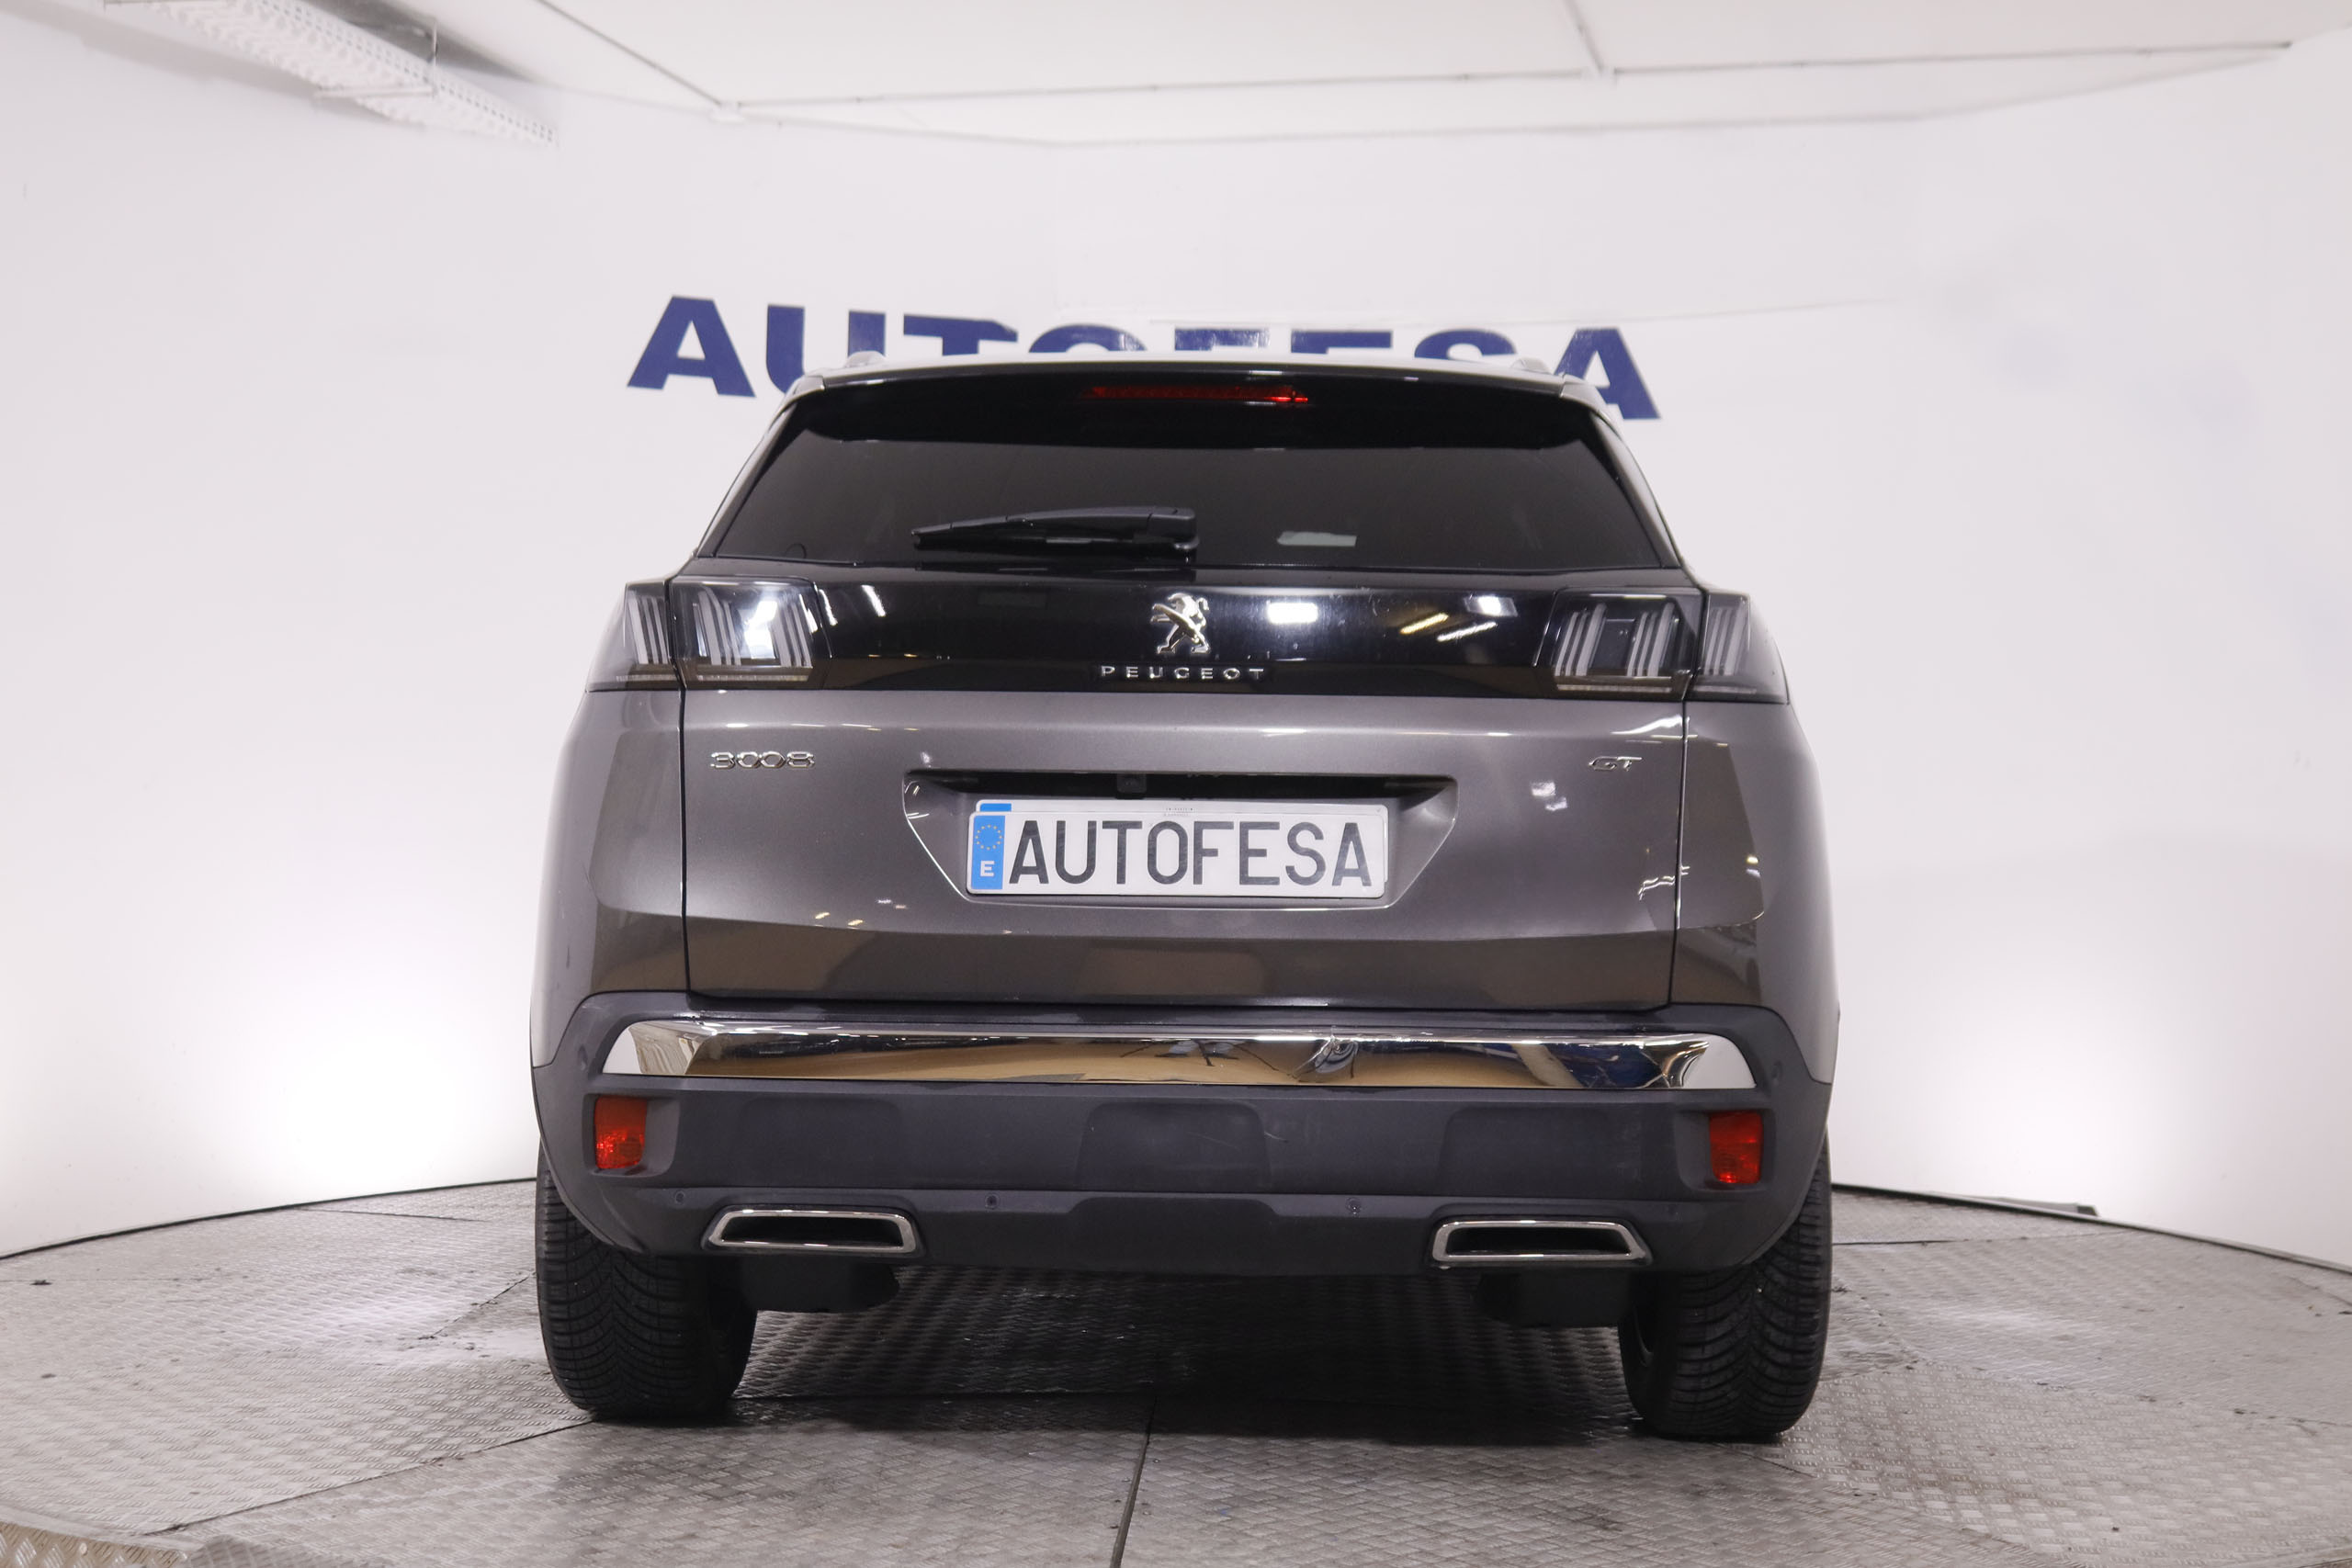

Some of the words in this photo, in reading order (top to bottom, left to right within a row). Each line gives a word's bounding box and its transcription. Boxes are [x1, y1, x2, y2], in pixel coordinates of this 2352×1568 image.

[628, 295, 1661, 420] AUTA
[1101, 665, 1264, 680] PEUGEOT
[710, 750, 815, 769] 3008
[1589, 756, 1643, 772] GT
[1009, 820, 1373, 886] AUTOFESA
[979, 861, 995, 878] E
